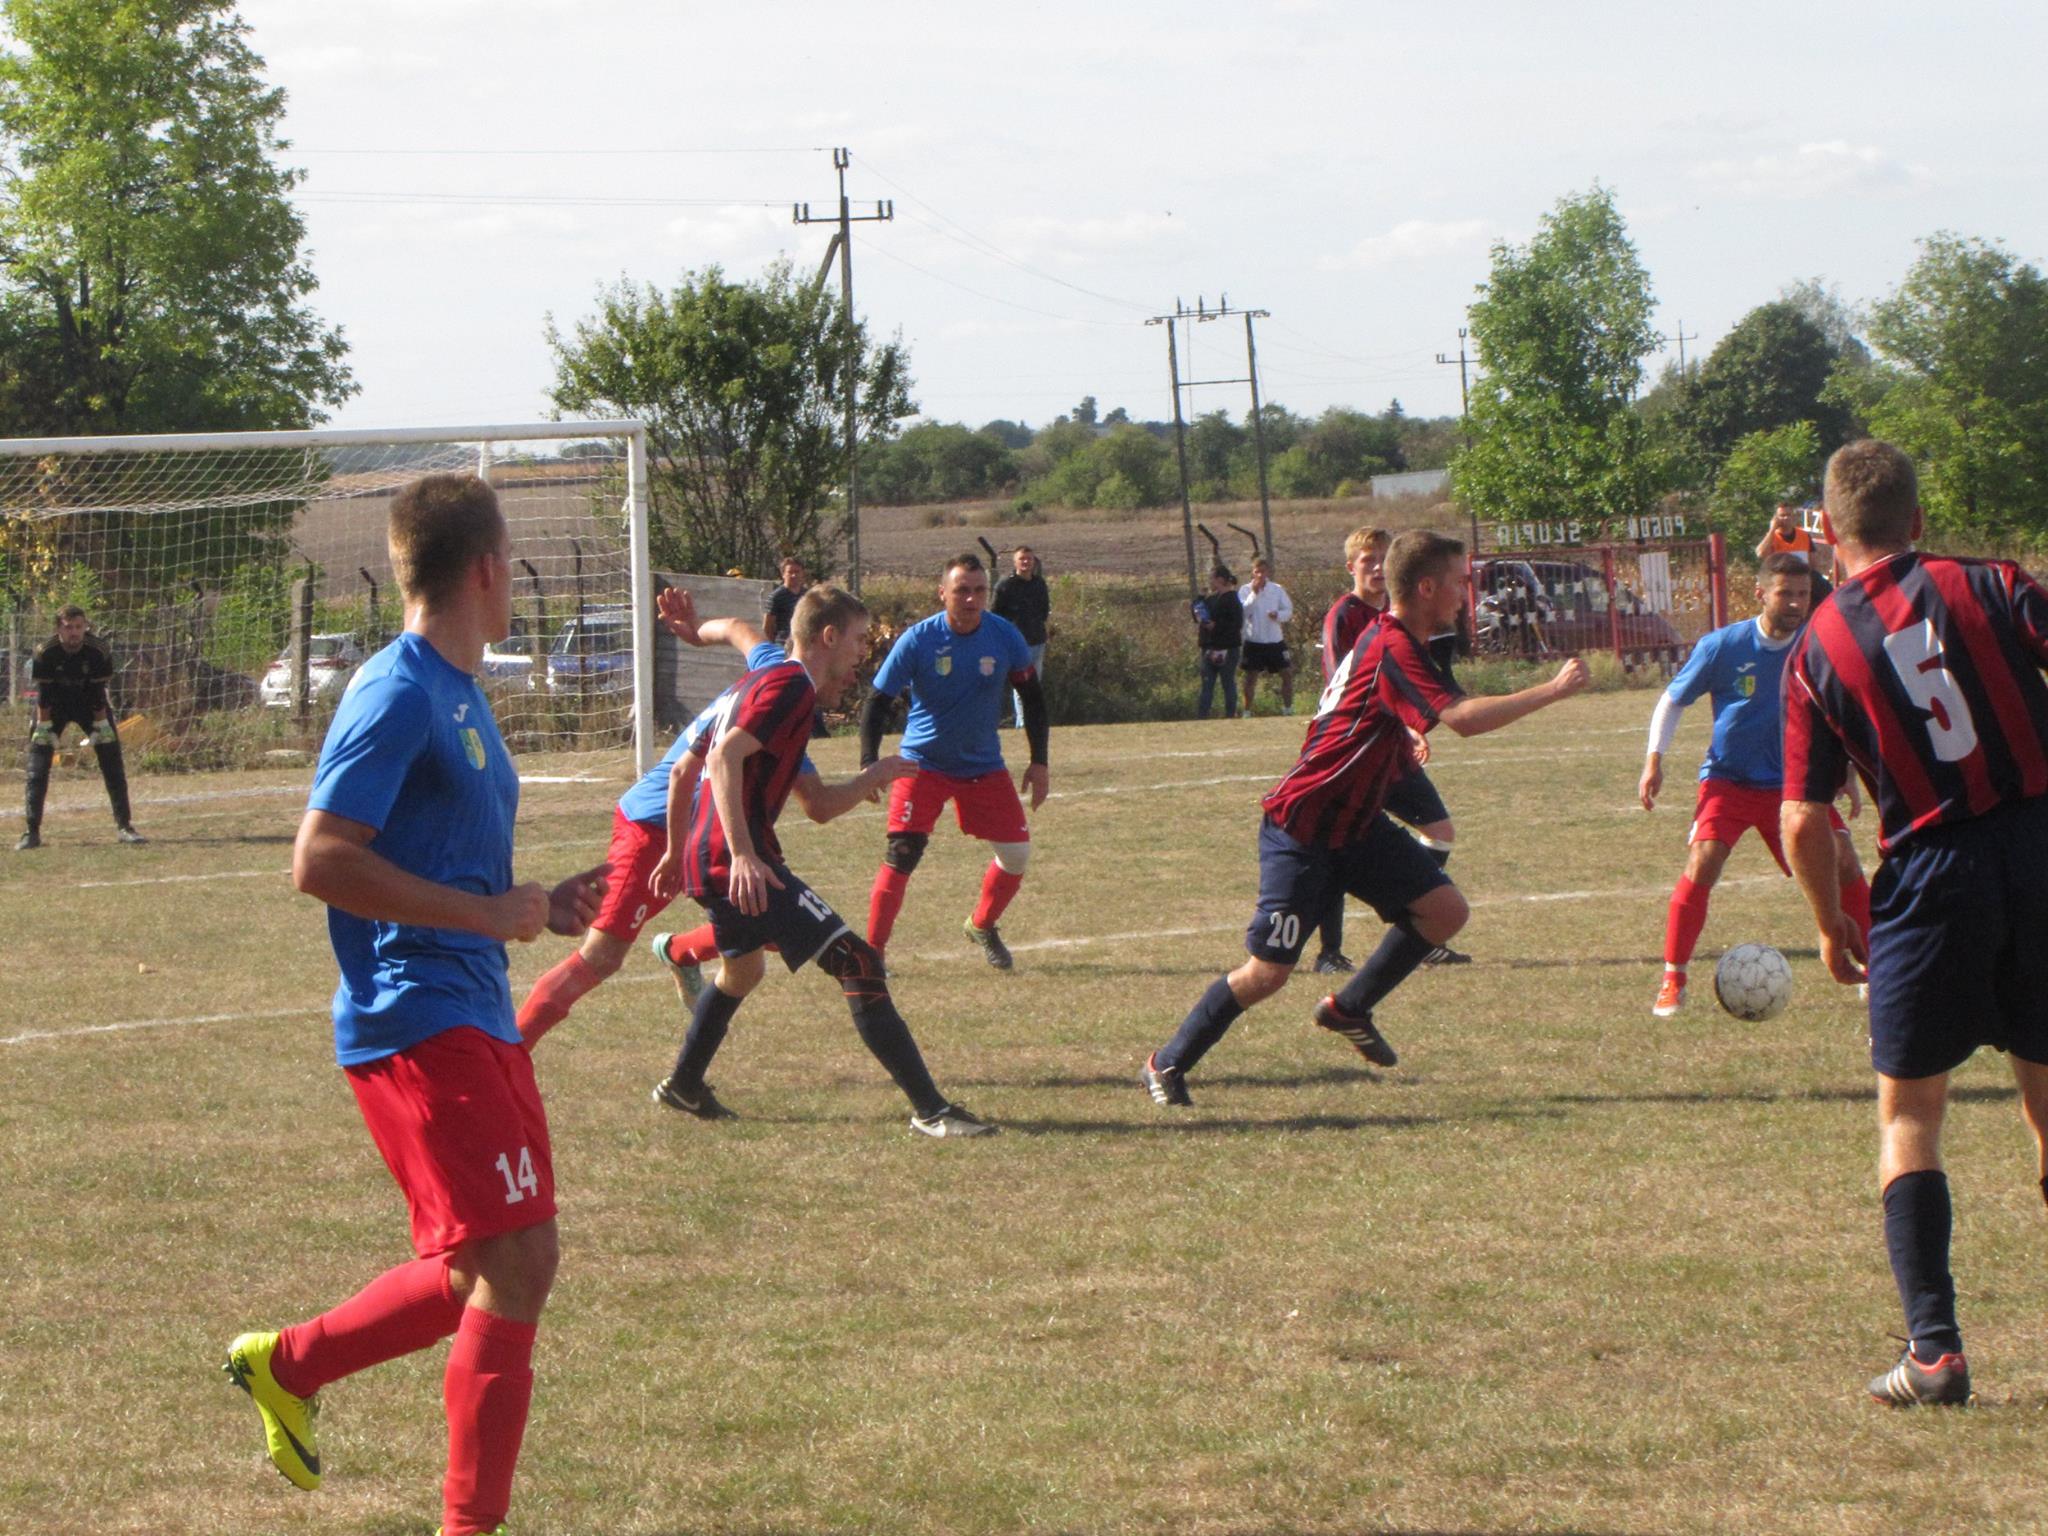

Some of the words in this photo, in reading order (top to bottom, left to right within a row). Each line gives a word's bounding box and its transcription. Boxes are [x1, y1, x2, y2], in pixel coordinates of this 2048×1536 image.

[1803, 508, 1825, 534] LZ
[1883, 618, 1977, 762] 5
[900, 801, 913, 822] 3
[630, 904, 648, 929] 9
[798, 889, 833, 923] 13
[1266, 911, 1300, 950] 20
[495, 1146, 537, 1203] 14
